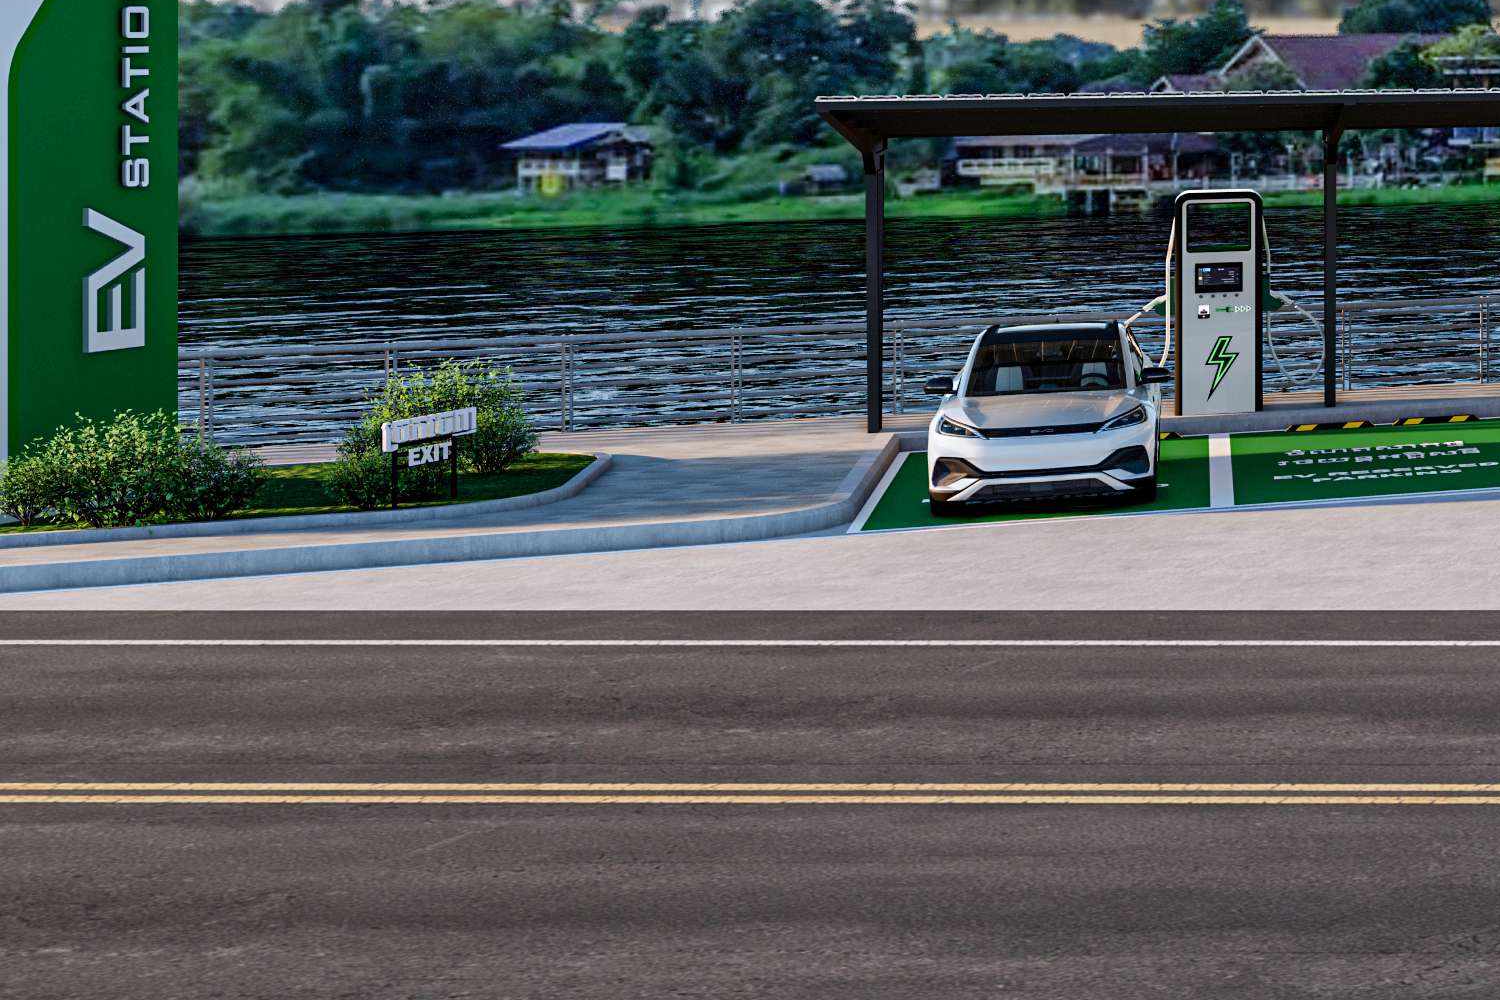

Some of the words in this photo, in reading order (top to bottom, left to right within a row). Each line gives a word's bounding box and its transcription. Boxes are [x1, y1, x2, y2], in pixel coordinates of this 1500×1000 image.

[82, 208, 145, 353] EV
[408, 440, 453, 467] EXIT
[1312, 469, 1462, 483] PARKING
[1328, 461, 1500, 477] RESERVED
